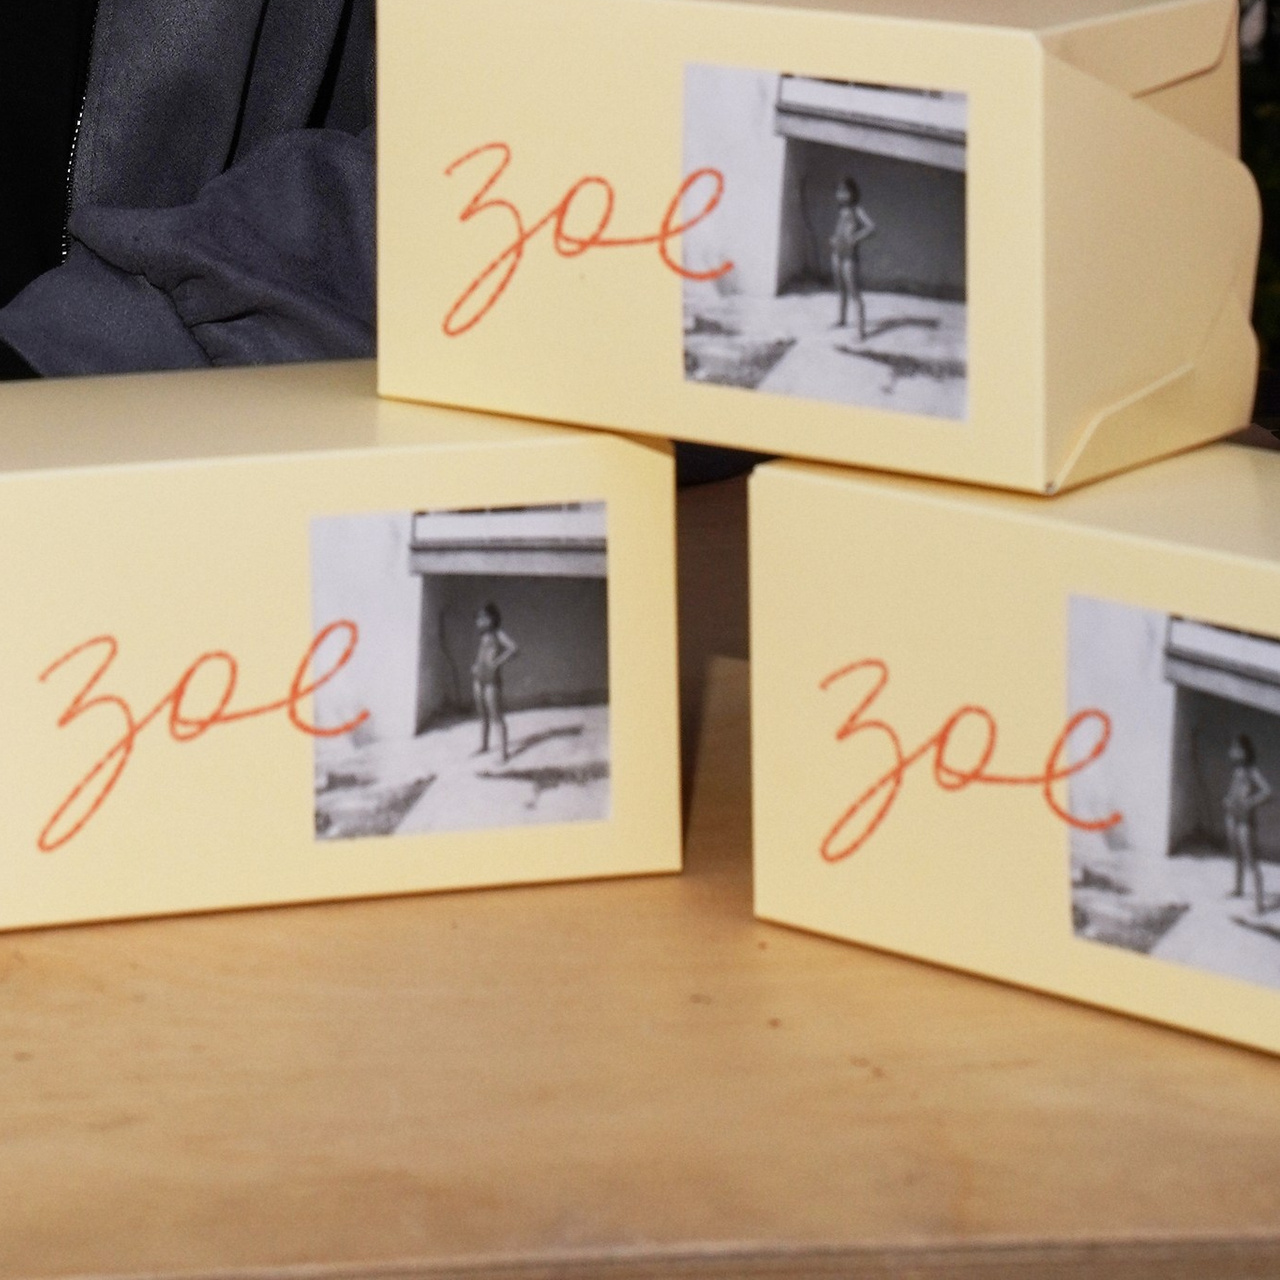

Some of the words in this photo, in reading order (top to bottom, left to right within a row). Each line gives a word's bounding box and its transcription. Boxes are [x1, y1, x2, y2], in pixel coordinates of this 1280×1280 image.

[442, 141, 736, 339] zoe
[36, 618, 372, 853] zoe
[817, 658, 1124, 864] zoe
